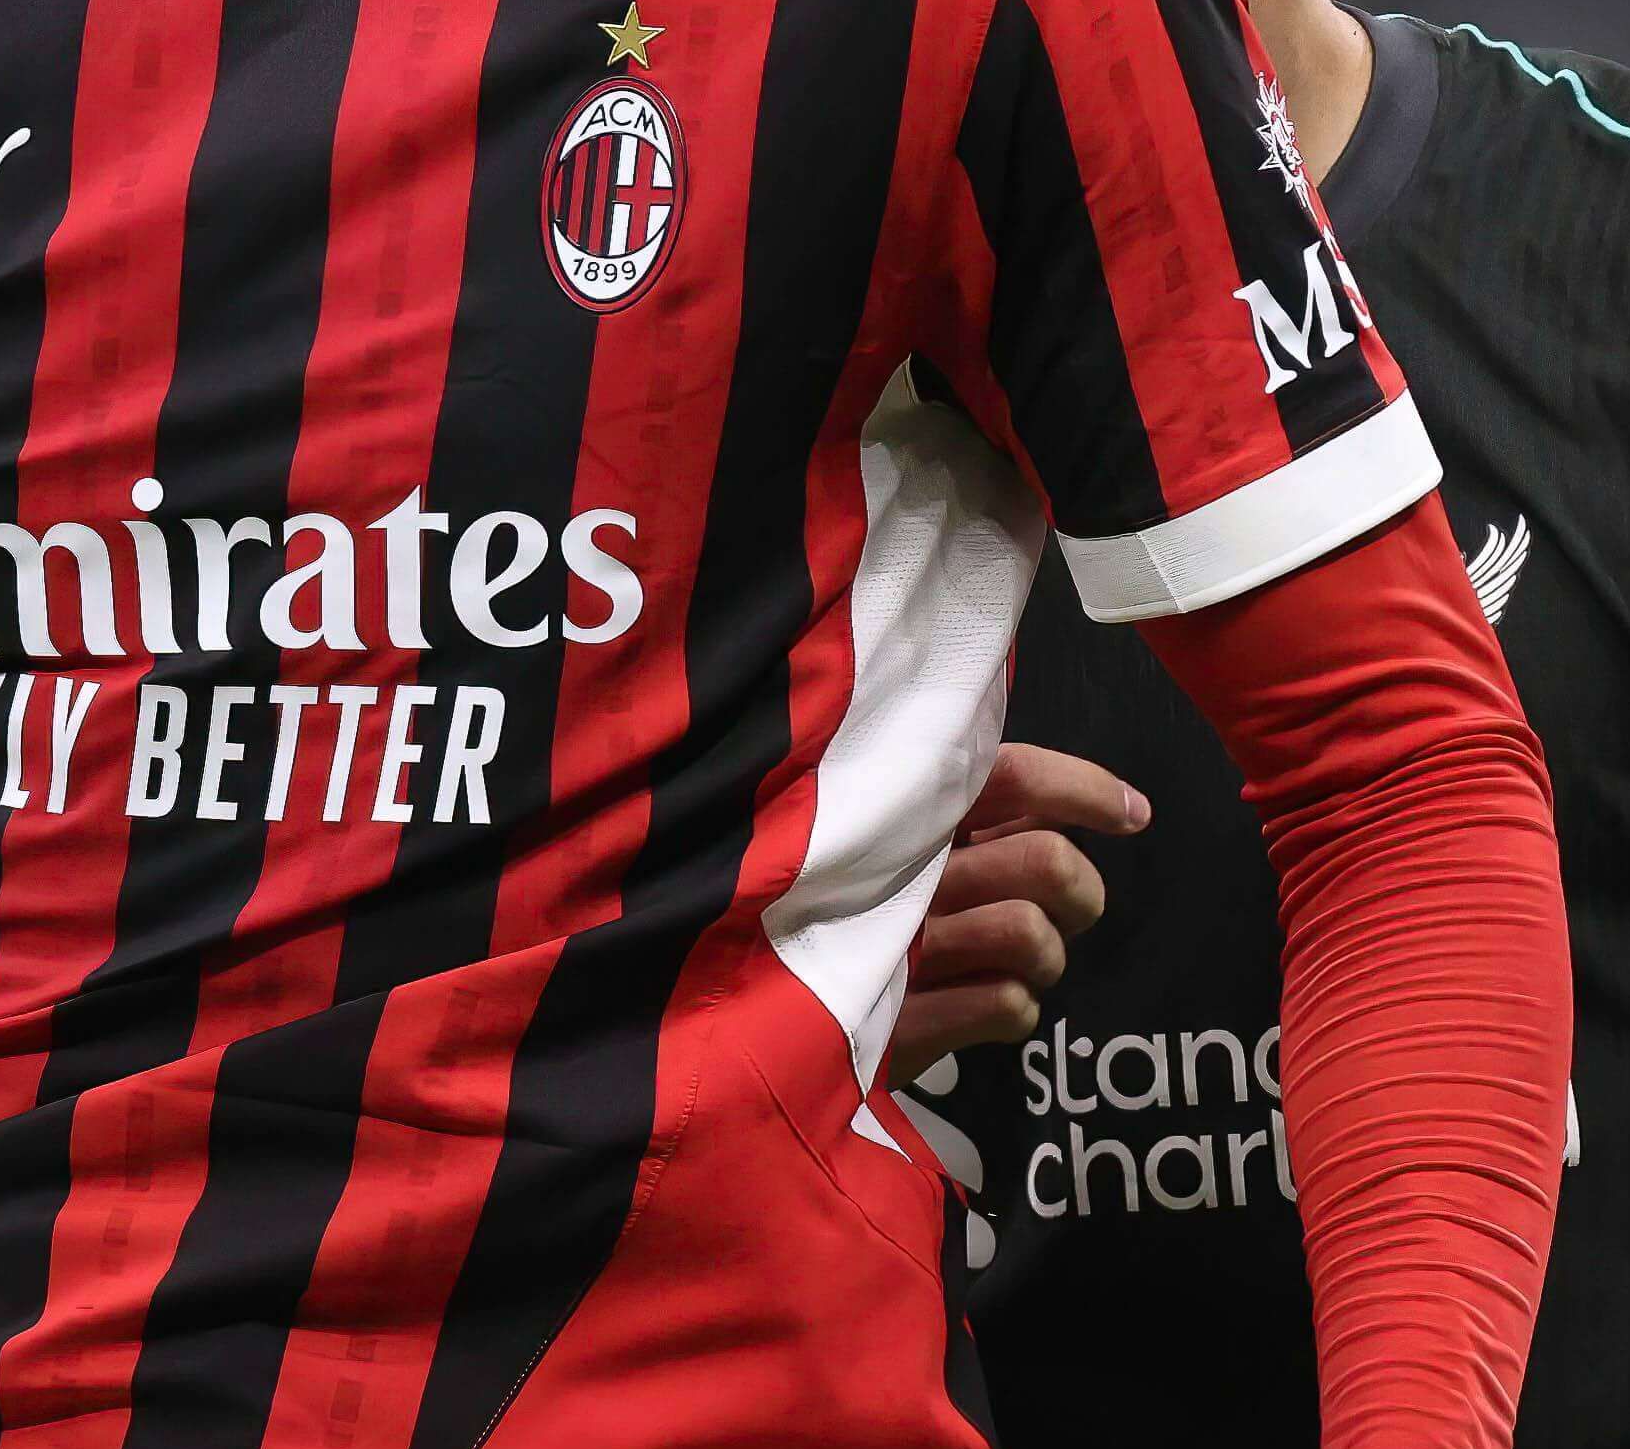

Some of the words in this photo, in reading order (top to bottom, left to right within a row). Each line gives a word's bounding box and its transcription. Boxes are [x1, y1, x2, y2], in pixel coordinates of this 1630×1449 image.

[579, 98, 658, 140] ACM
[573, 258, 636, 282] 1899
[125, 684, 508, 825] BETTER
